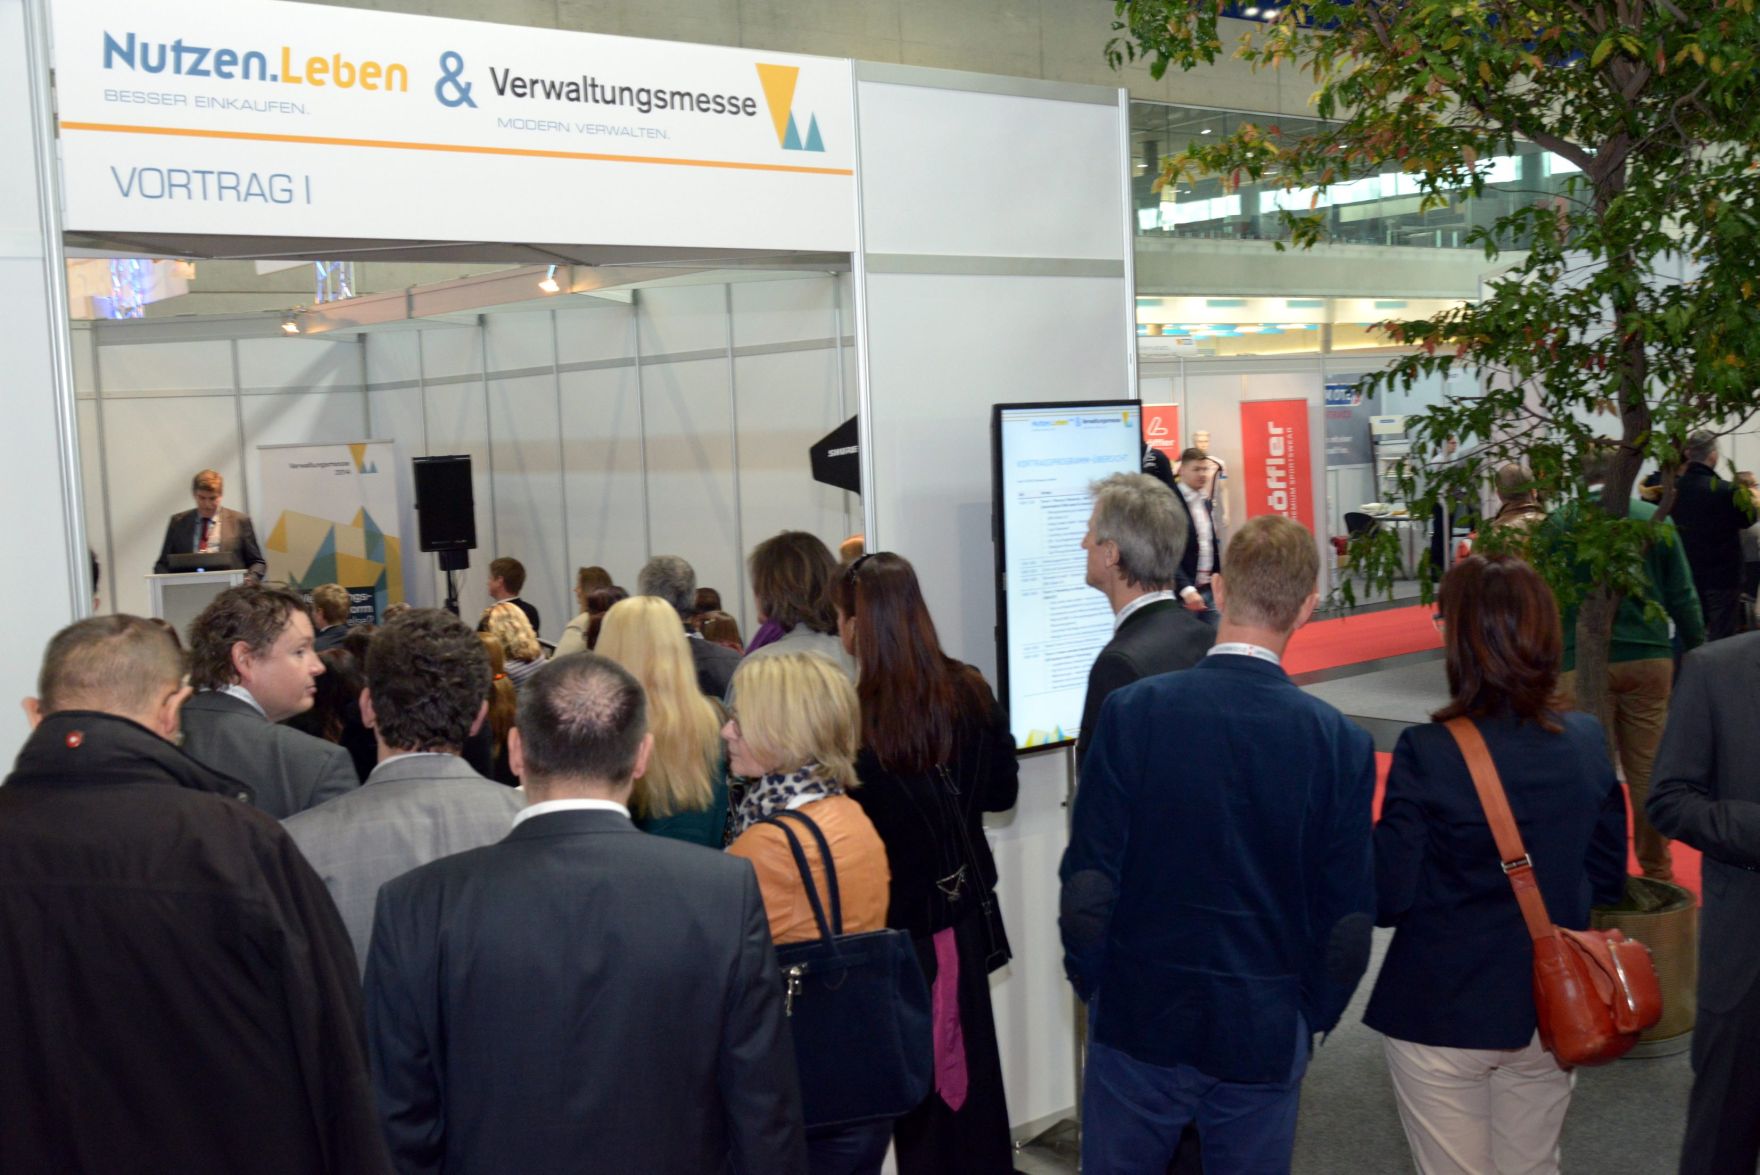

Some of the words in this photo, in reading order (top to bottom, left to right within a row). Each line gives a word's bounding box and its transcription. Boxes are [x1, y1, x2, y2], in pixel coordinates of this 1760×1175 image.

[103, 30, 408, 92] Nutzen.Leben
[434, 50, 478, 109] &
[488, 66, 758, 117] Verwaltungsmesse
[103, 88, 188, 106] BESSER
[194, 95, 312, 115] EINKAUFEN.
[497, 117, 571, 134] MODERN
[575, 123, 671, 140] VERWALTEN.
[110, 165, 293, 205] VORTRAG
[304, 175, 312, 205] I
[1265, 421, 1289, 518] öffler
